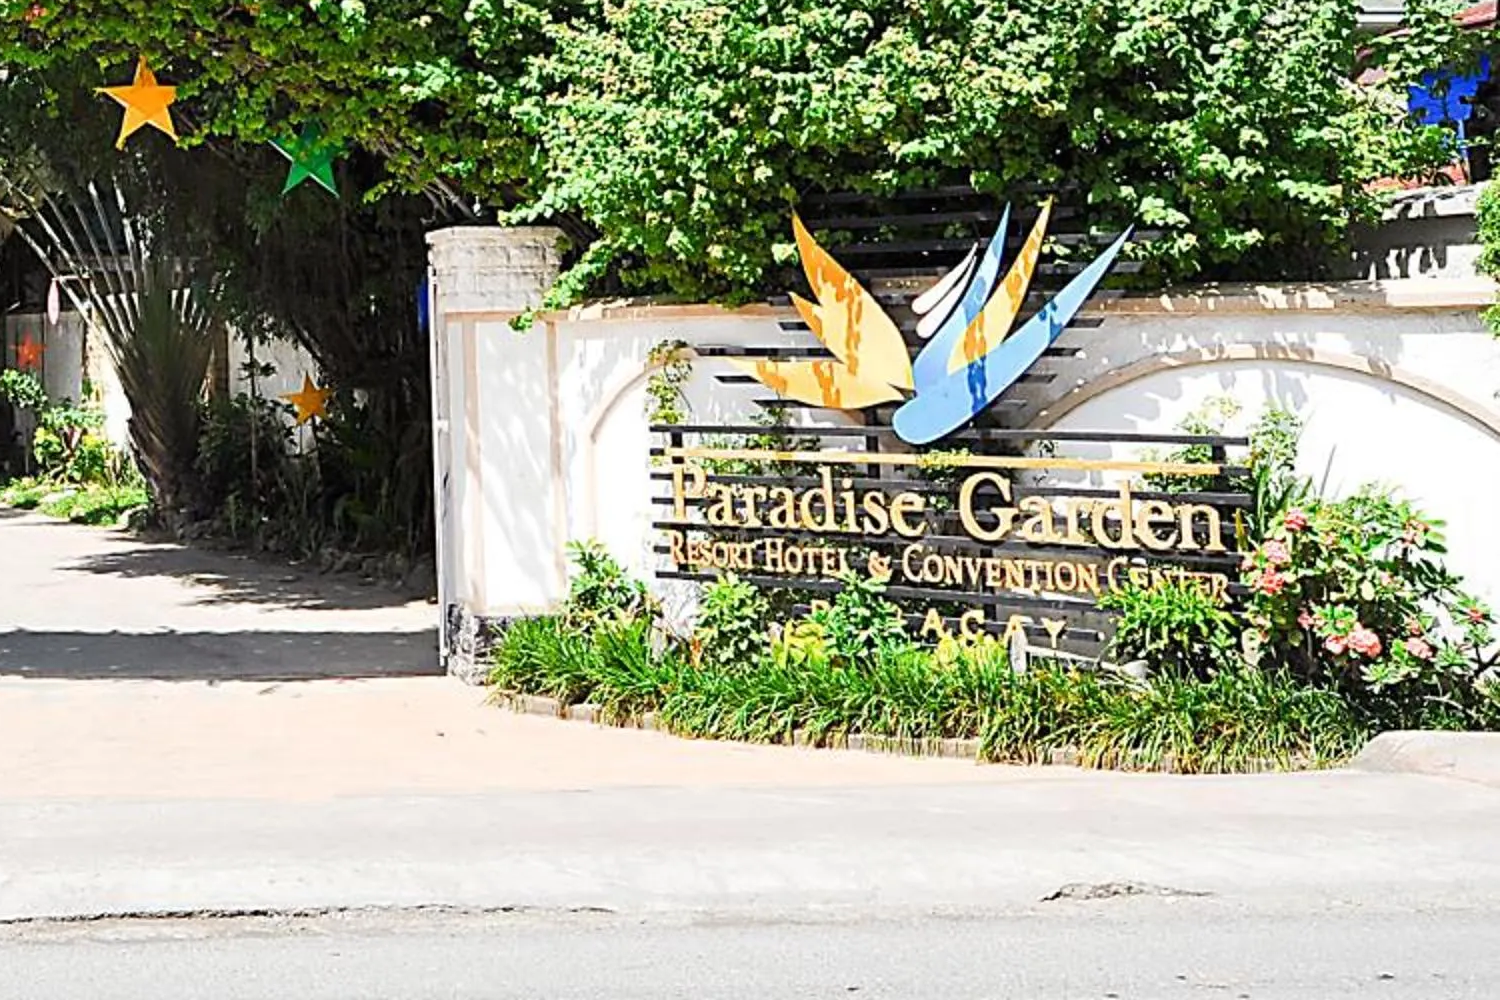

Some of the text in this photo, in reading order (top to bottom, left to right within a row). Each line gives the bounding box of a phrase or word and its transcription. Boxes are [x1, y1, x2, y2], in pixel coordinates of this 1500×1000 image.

[669, 462, 1228, 552] Paradise Garden
[668, 530, 755, 569] RESORT
[764, 537, 849, 577] HOTEL
[868, 551, 892, 580] &
[902, 543, 1101, 594] CONVENTION
